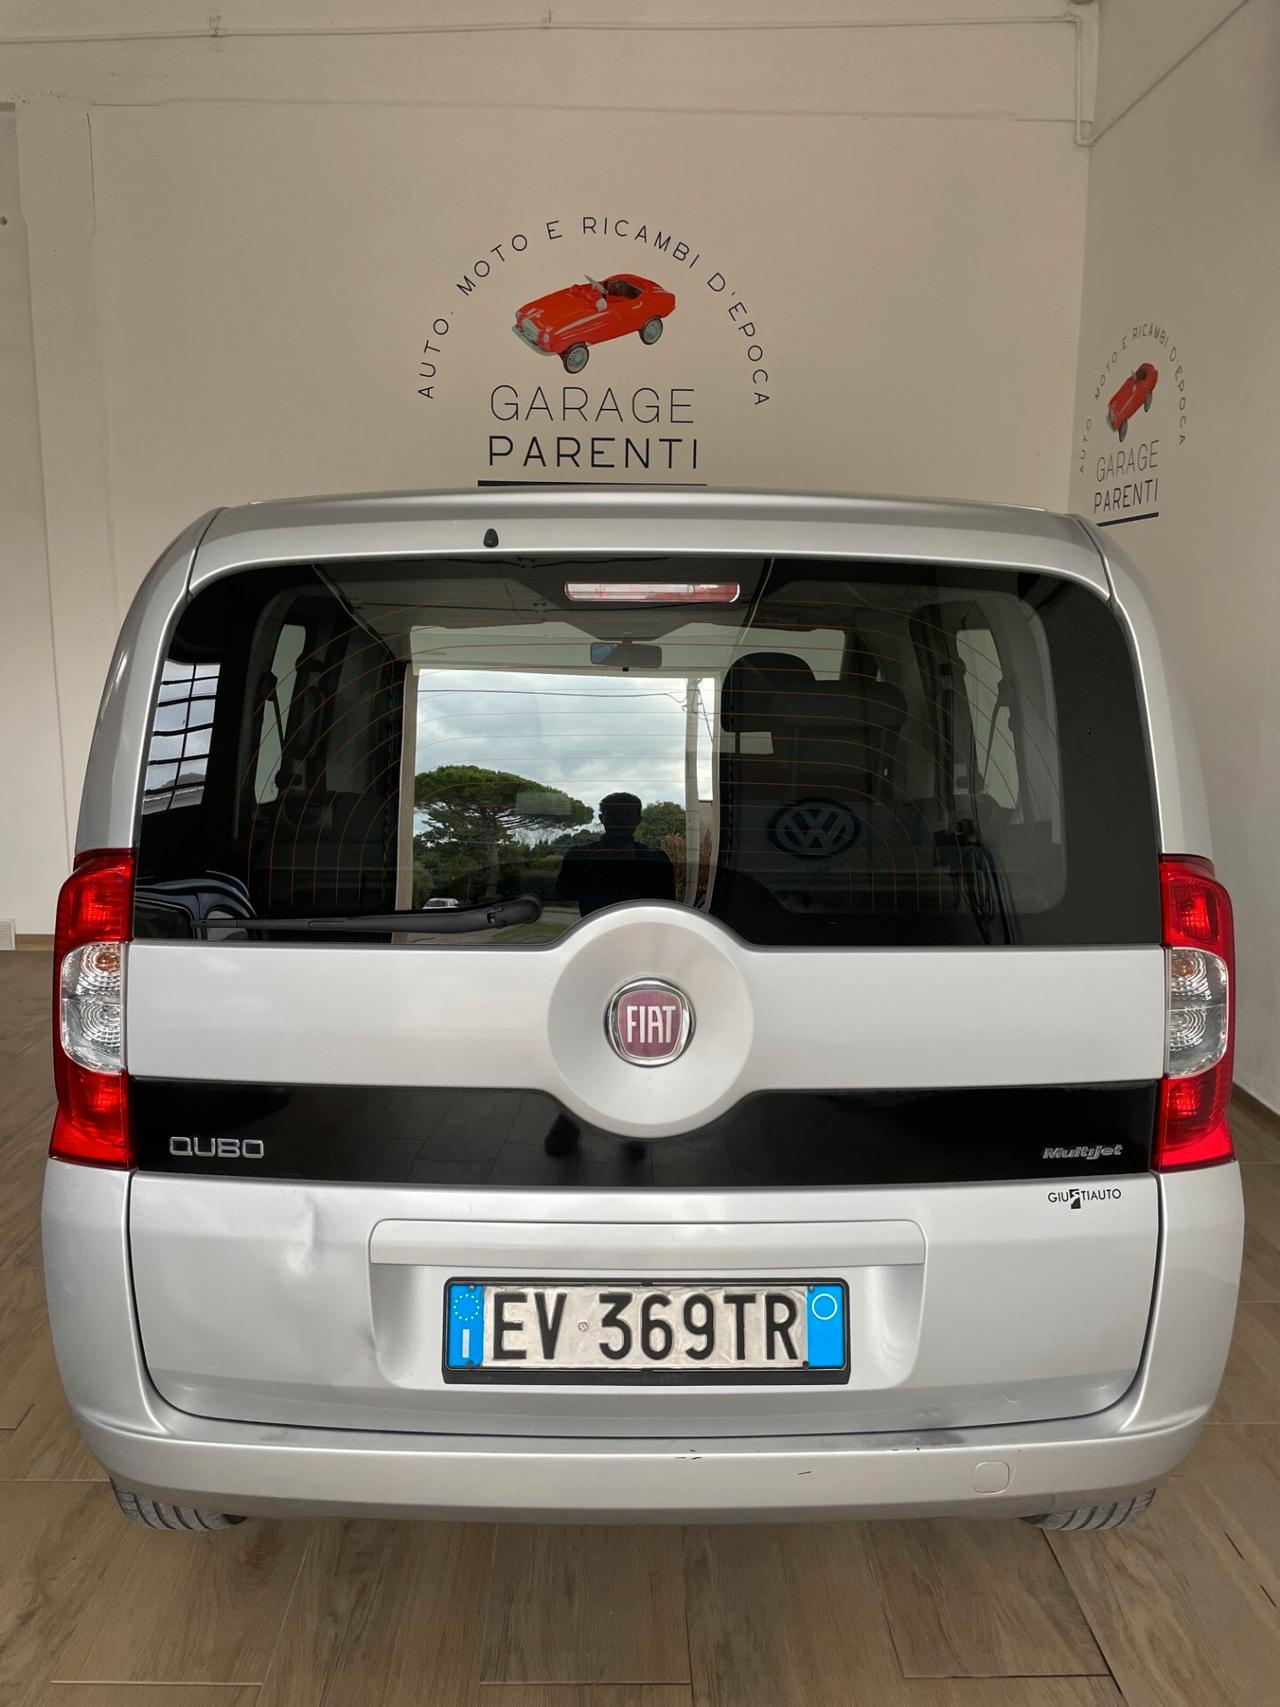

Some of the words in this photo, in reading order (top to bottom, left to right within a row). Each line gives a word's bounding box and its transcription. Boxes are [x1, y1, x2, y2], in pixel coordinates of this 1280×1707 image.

[456, 234, 528, 296] MOTO
[546, 220, 563, 240] E
[582, 216, 700, 269] RICAMBI
[707, 272, 770, 406] D'EPOCA
[1132, 322, 1170, 349] RICAMBI
[490, 384, 695, 424] GARAGE
[488, 435, 697, 469] PARENTI
[1096, 439, 1160, 483] GARAGE
[1093, 478, 1159, 514] PARENTI
[626, 1005, 676, 1044] FIAT
[169, 1136, 265, 1158] QUBO
[1042, 1144, 1123, 1160] Multijet
[493, 1292, 567, 1360] EV
[598, 1292, 799, 1361] 369TR
